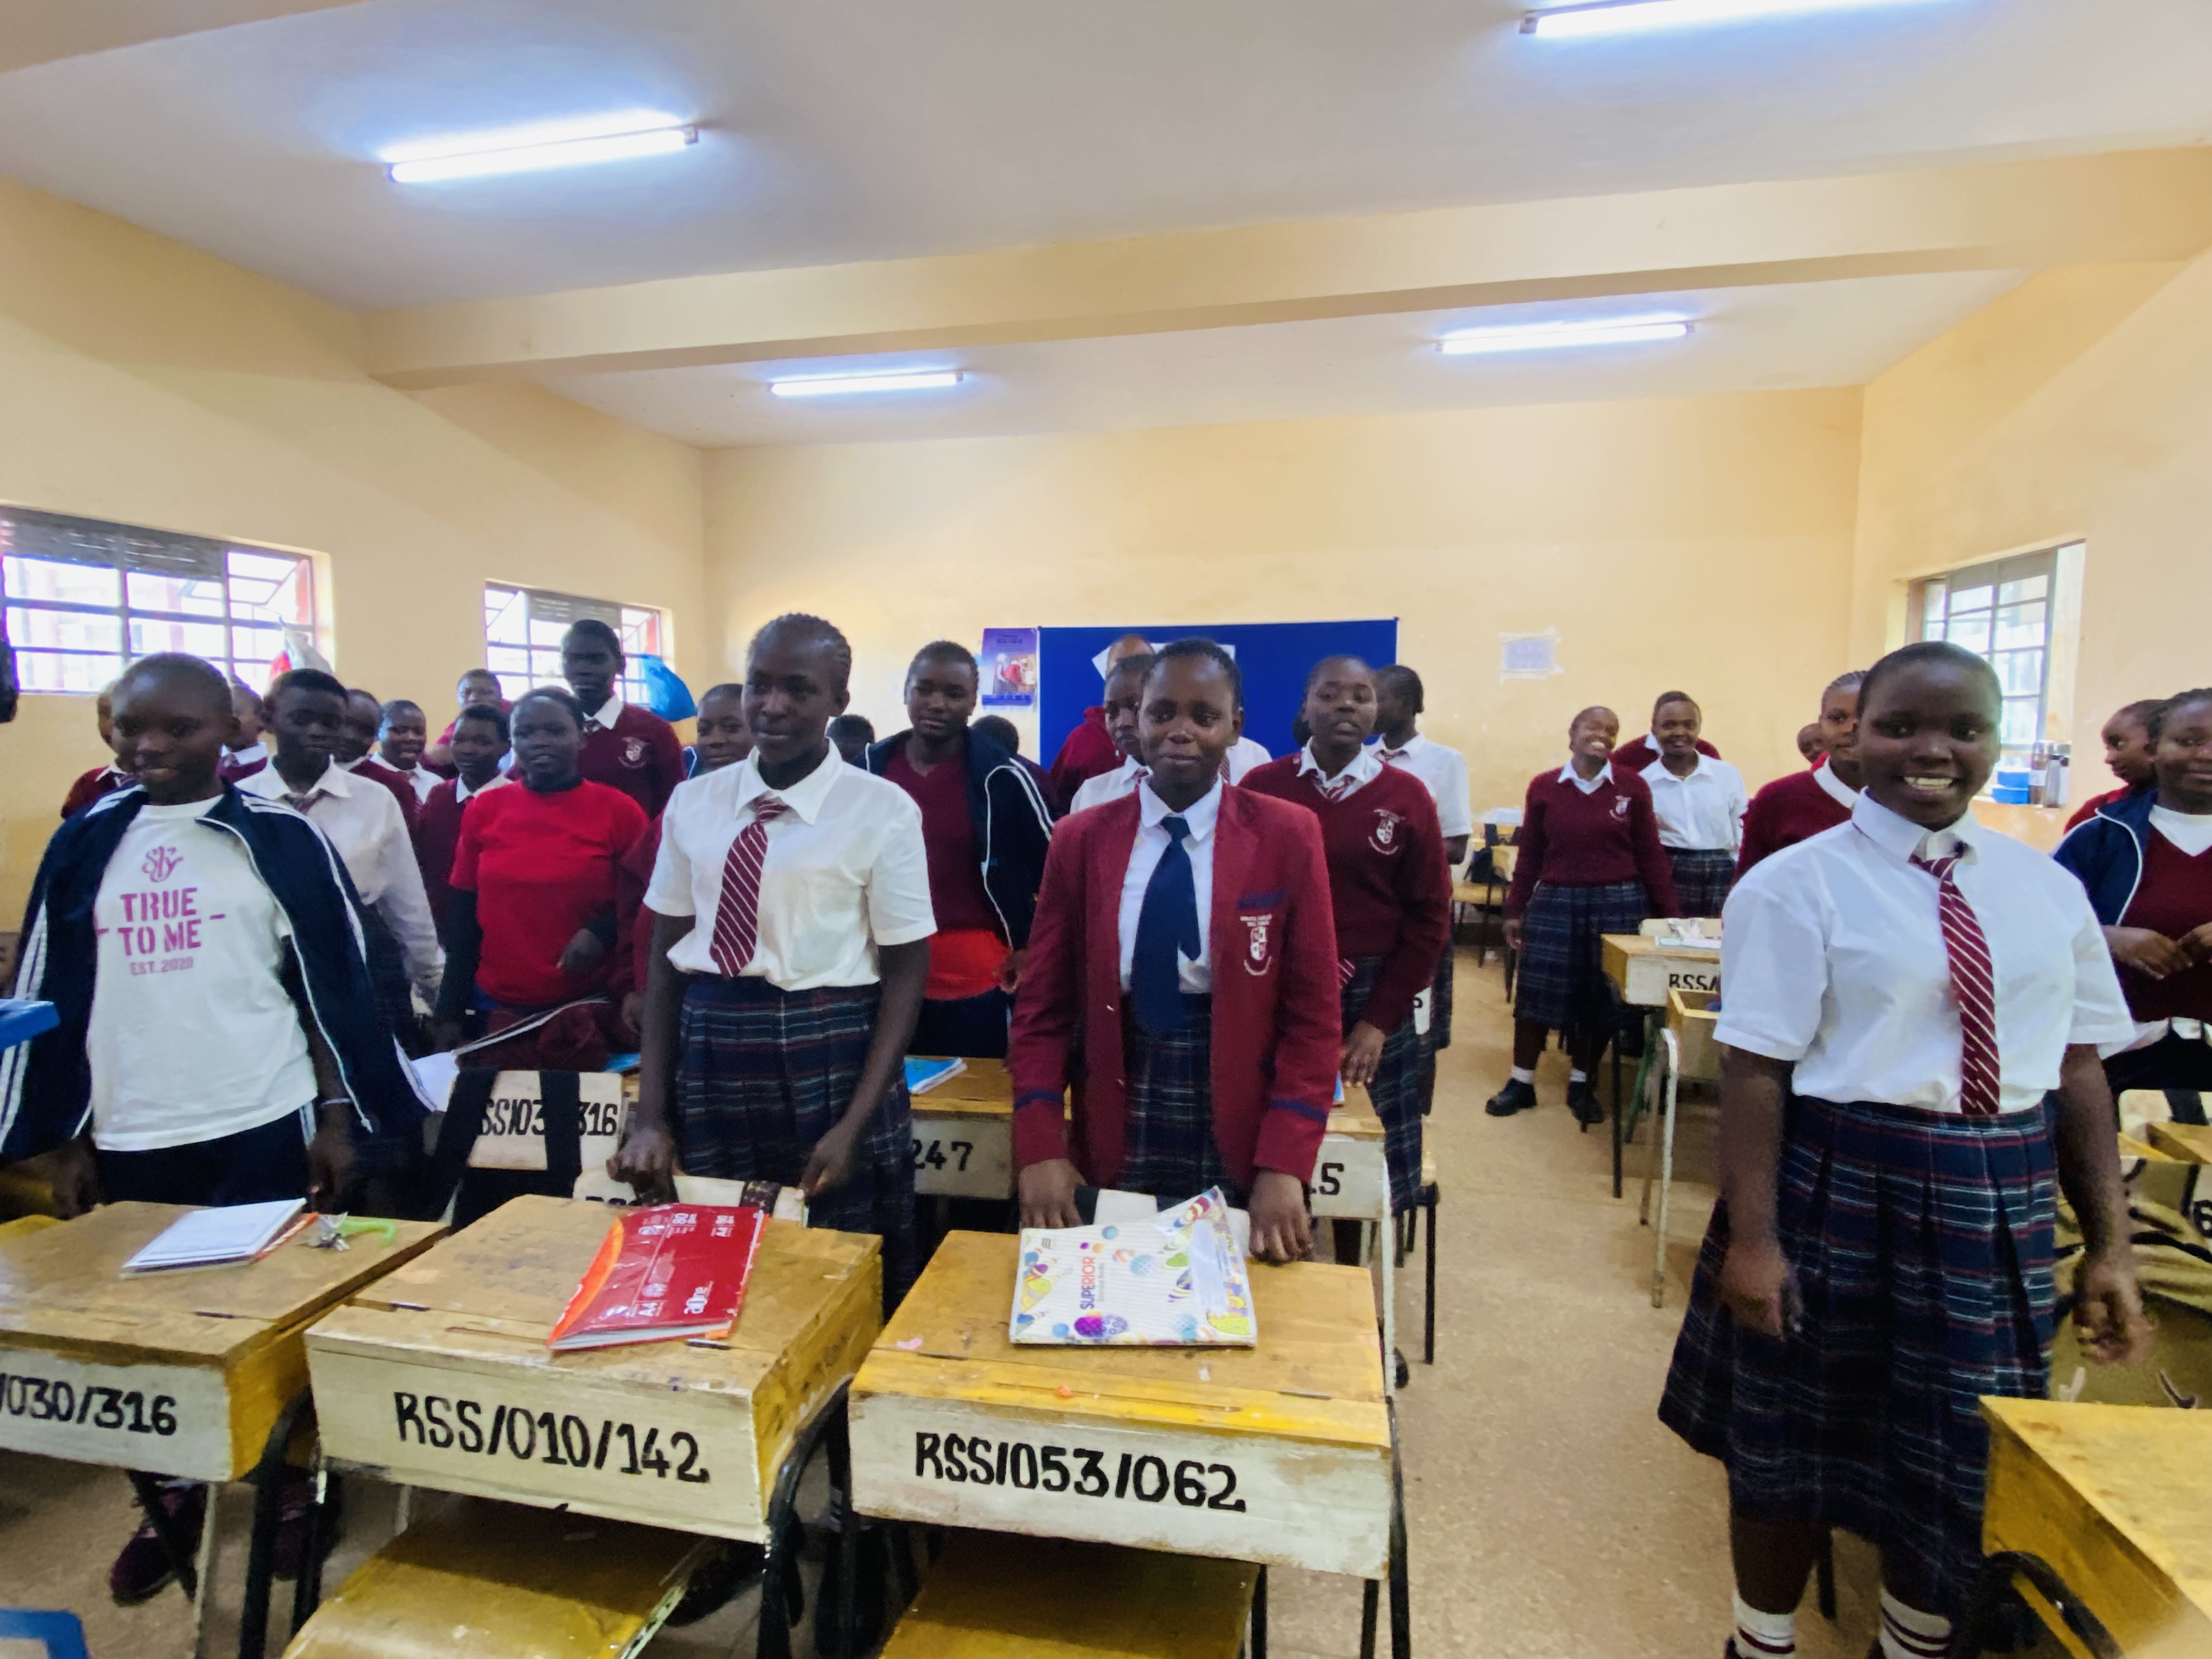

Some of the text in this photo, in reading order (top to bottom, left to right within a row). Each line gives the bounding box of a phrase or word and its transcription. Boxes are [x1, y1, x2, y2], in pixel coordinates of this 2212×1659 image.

[120, 887, 198, 922] TRUE
[117, 919, 202, 956] TO ME
[1311, 1163, 1344, 1195] 5
[1080, 1256, 1096, 1310] SUPERIOR
[639, 1302, 658, 1317] A4
[394, 1391, 710, 1483] RSS/010/142
[915, 1432, 1247, 1513] RSS/053/062
